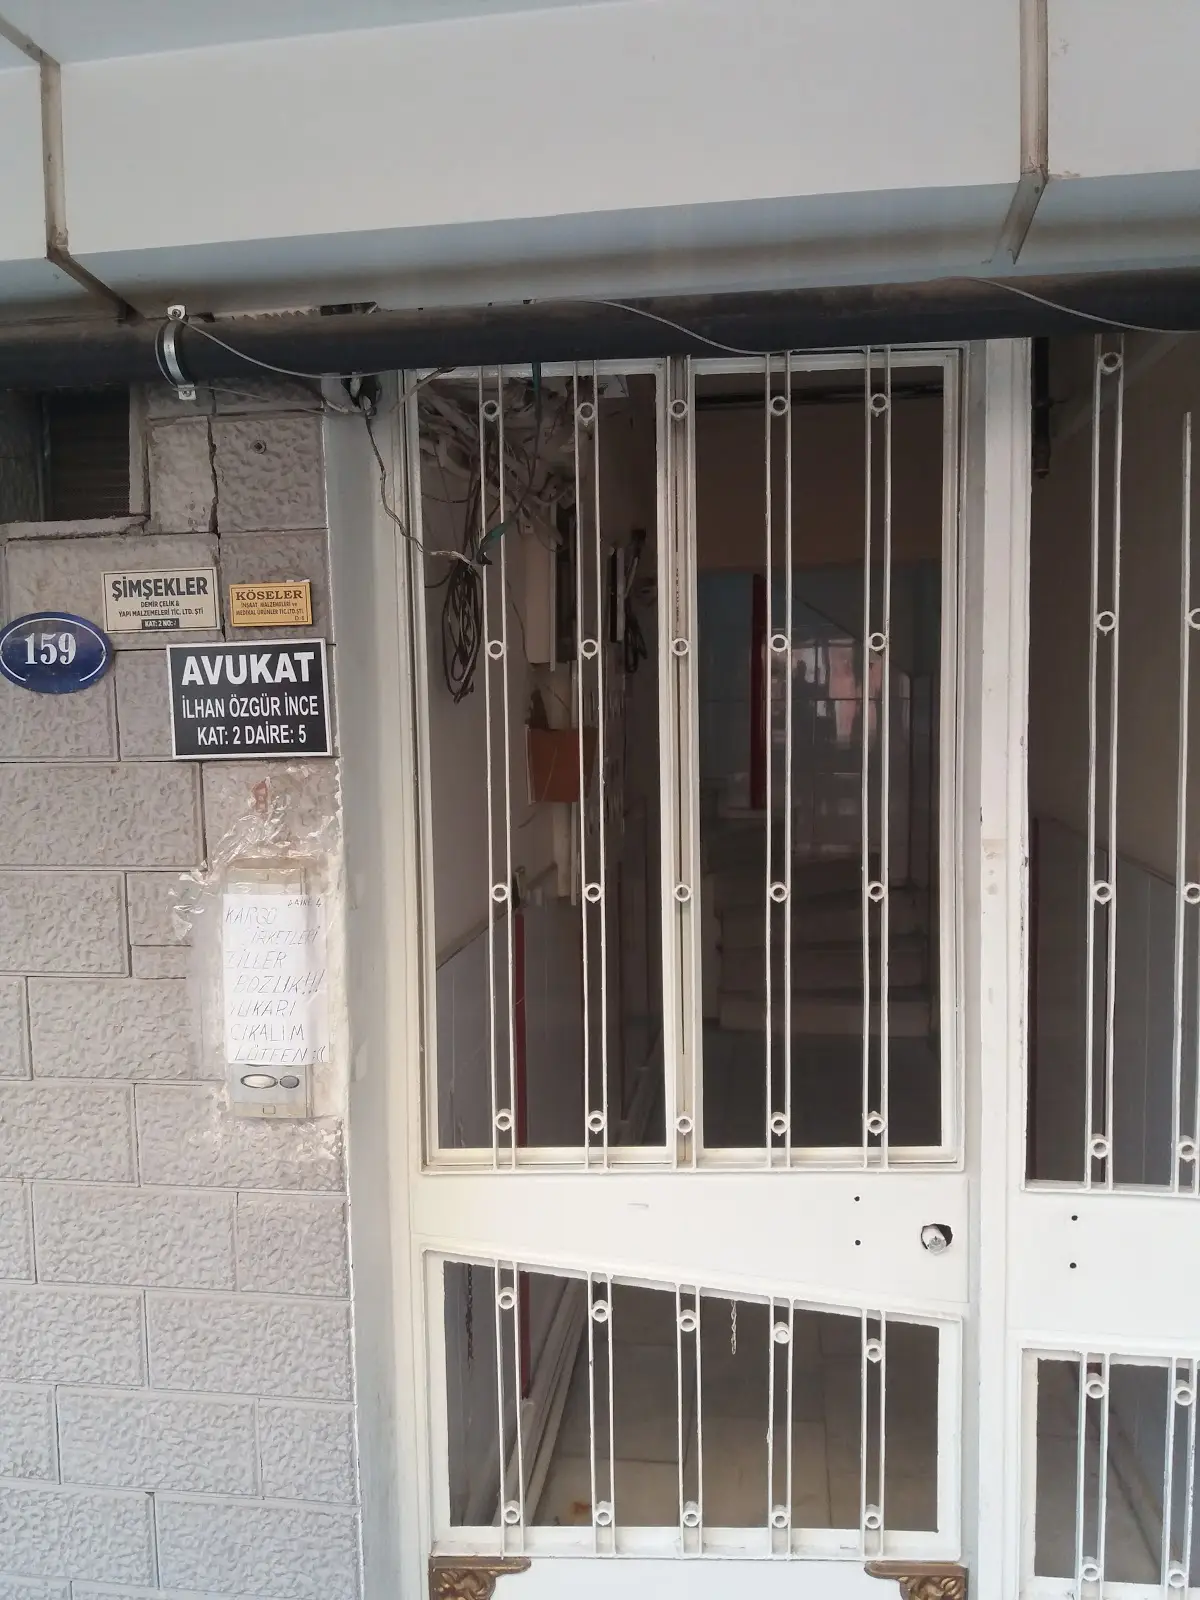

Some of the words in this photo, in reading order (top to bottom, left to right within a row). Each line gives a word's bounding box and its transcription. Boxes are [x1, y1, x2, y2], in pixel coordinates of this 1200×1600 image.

[111, 576, 208, 602] ŞİMŞEKLER
[235, 589, 303, 601] KÖSELER
[132, 608, 170, 617] MALZEMELERİ
[182, 608, 194, 616] LTD.
[140, 600, 158, 608] DEMİR
[159, 599, 175, 608] ÇELİK
[24, 632, 77, 665] 159
[181, 651, 315, 686] AVUKAT
[182, 695, 225, 719] İLHAN
[229, 693, 282, 718] ÖZGÜR
[284, 691, 319, 717] İNCE
[197, 726, 229, 746] KAT:
[232, 725, 241, 745] 2
[244, 720, 294, 745] DAİRE:
[298, 724, 307, 744] 5
